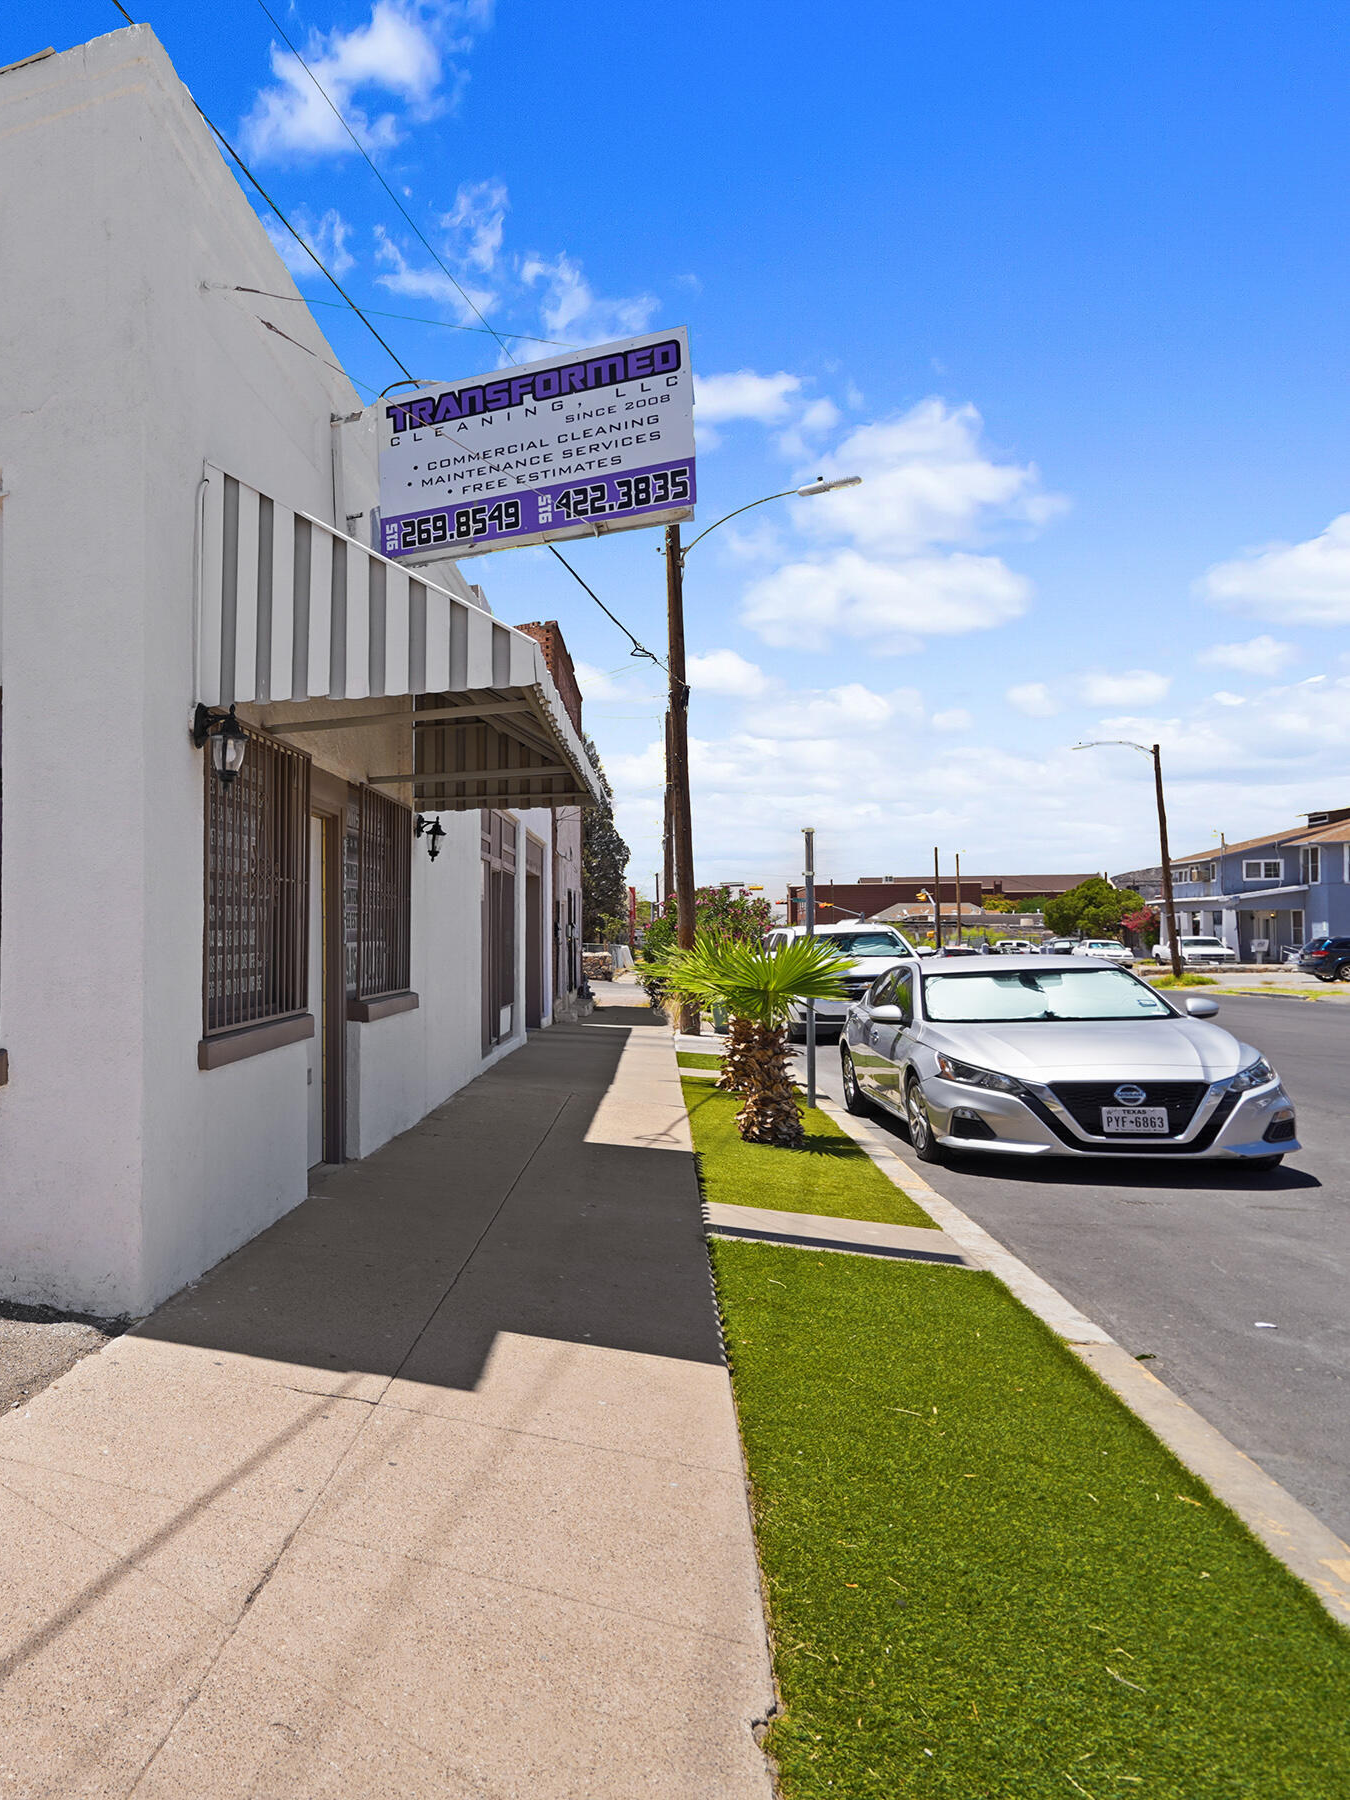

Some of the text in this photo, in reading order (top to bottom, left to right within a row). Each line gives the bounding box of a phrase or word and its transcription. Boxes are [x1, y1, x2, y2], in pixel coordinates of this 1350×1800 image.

[386, 339, 681, 434] TRANSFORMED
[390, 375, 678, 447] CLEANING, LLC
[564, 394, 671, 424] SINCE 2008
[421, 430, 661, 488] MAINTENANCE SERVICES
[427, 414, 660, 471] COMMERCIAL CLEANING
[462, 455, 622, 495] FREE ESTIMATES
[554, 466, 690, 521] 422.3835
[400, 499, 522, 550] 269.8549
[537, 494, 553, 524] 915
[385, 523, 399, 551] 915
